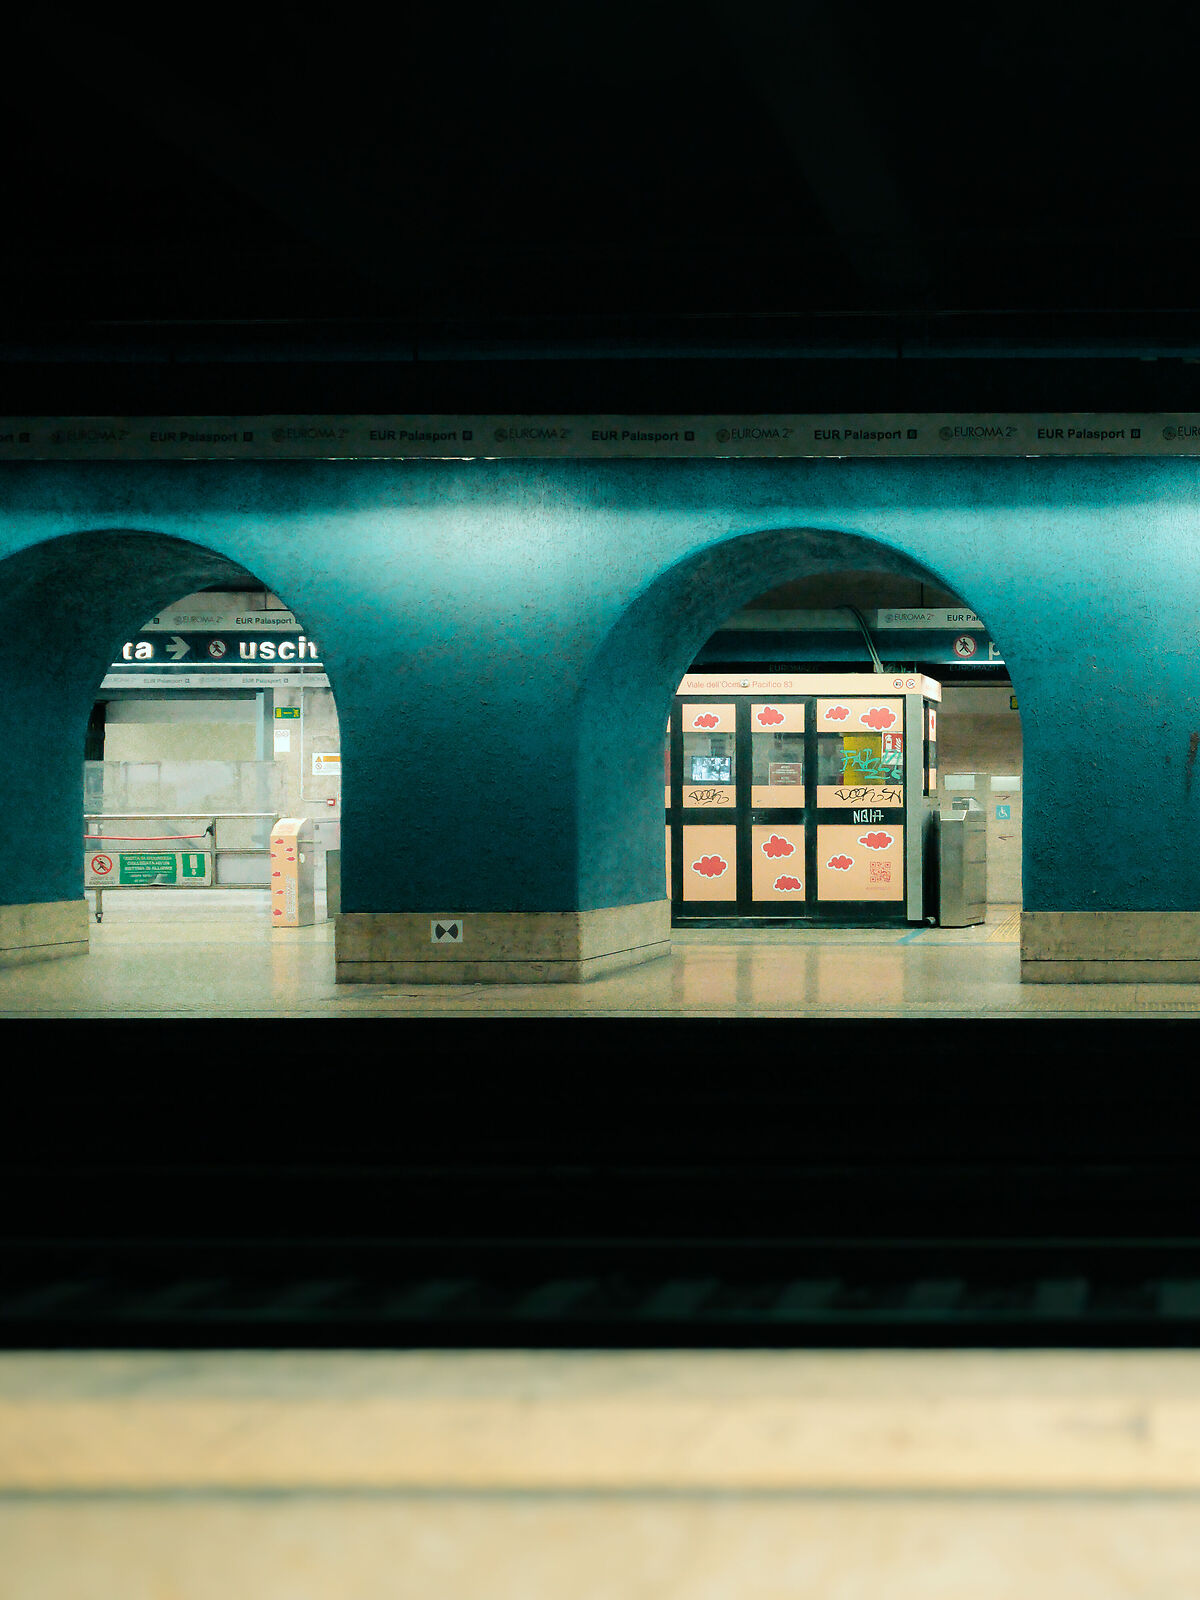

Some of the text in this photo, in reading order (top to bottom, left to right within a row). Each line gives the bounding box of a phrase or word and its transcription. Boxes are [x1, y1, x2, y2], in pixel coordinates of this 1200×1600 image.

[370, 431, 457, 444] EUR Palasport
[592, 430, 679, 443] EUR Palasport
[731, 428, 780, 439] EUROMA
[814, 430, 840, 440] EUR
[844, 430, 902, 443] Palasport
[954, 426, 1002, 437] EUROMA
[1037, 429, 1064, 439] EUR
[1067, 428, 1125, 442] Palasport
[256, 617, 292, 626] Palasport
